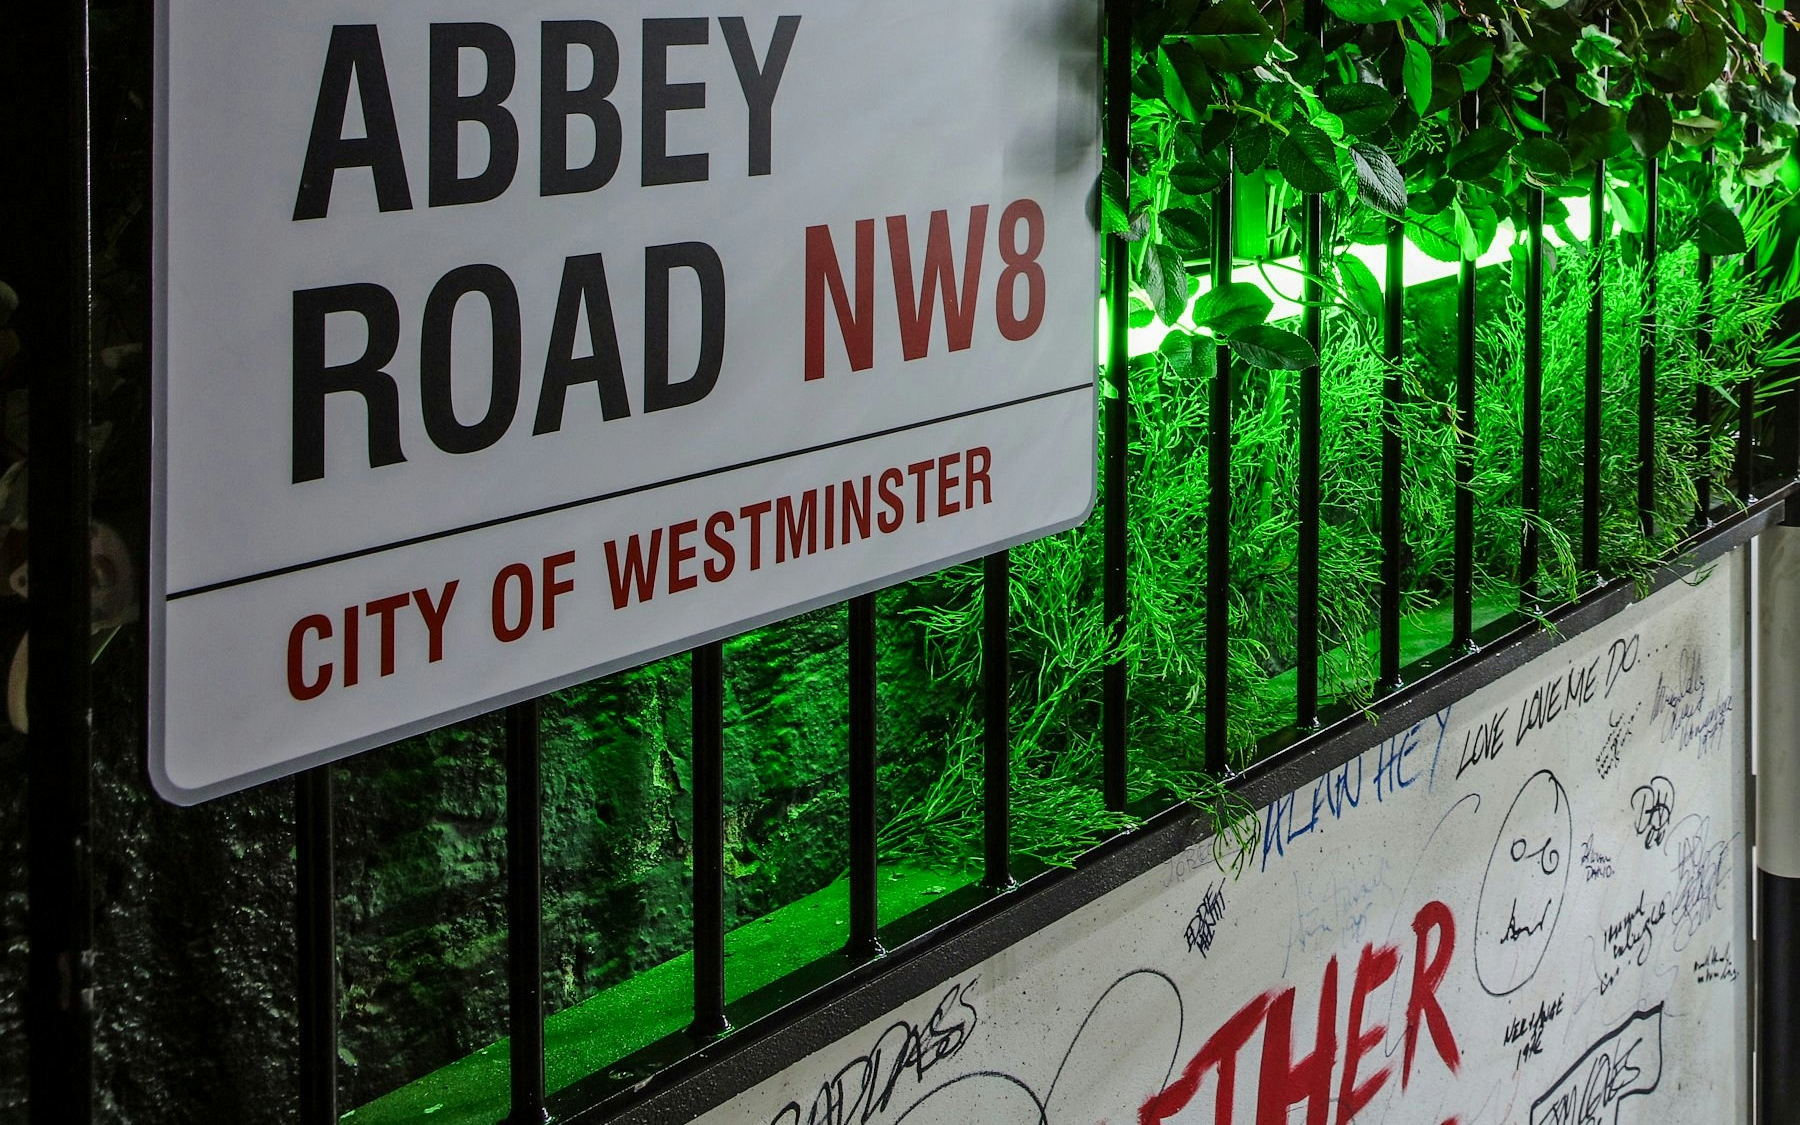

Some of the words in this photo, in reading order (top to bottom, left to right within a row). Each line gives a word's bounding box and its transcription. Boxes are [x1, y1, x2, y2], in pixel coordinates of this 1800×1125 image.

[292, 14, 803, 222] ABBEY
[292, 240, 727, 485] ROAD
[803, 198, 1047, 382] NW8
[286, 579, 461, 703] CITY
[491, 549, 576, 644] OF
[603, 445, 994, 611] WESTMINSTER
[1373, 704, 1452, 803] HEY
[1456, 706, 1509, 781] LOVE
[1515, 676, 1563, 747] LOVE
[1564, 655, 1600, 710] ME
[1137, 899, 1464, 1125] THER
